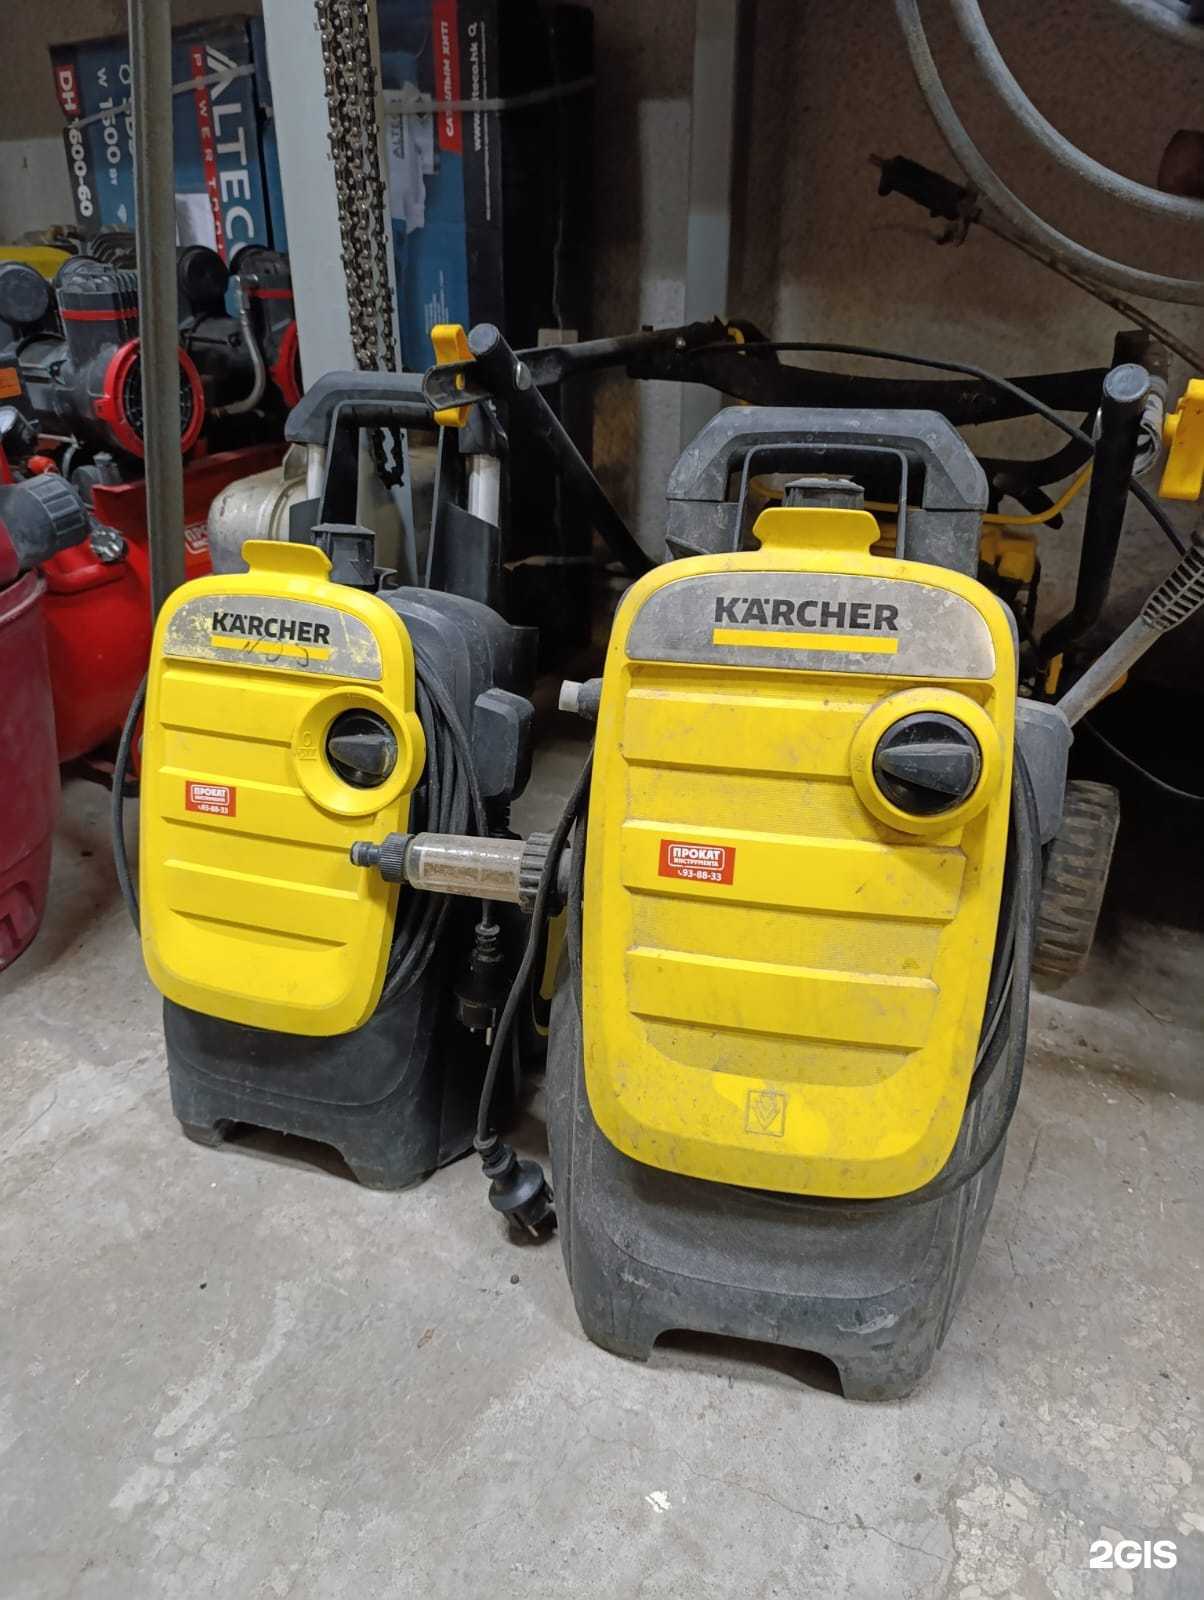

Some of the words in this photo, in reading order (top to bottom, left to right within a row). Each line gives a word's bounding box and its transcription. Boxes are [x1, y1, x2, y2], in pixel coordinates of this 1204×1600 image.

[58, 70, 77, 111] DH
[205, 45, 255, 260] ALTEC
[212, 611, 330, 645] KÄRCHER
[714, 596, 899, 631] KÄRCHER
[673, 847, 720, 860] ПРОКАТ
[682, 868, 722, 881] 93-88-33
